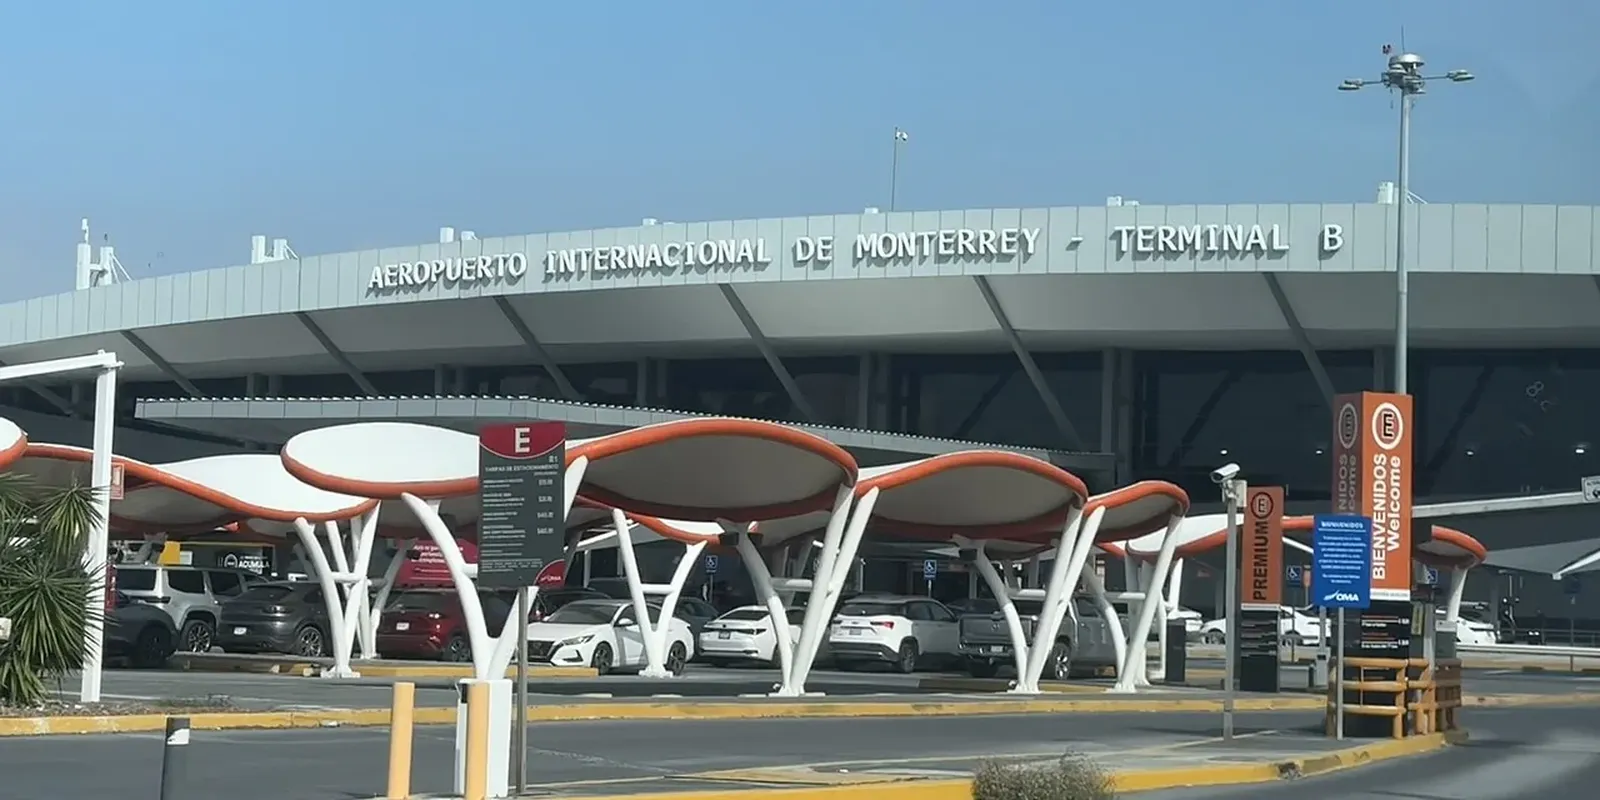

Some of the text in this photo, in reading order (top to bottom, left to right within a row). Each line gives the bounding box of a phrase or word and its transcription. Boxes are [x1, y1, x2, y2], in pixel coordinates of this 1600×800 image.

[367, 252, 527, 289] AEROPUERTO
[545, 238, 771, 275] INTERNACIONAL
[795, 236, 833, 262] DE
[856, 228, 1040, 260] MONTERREY
[1114, 223, 1289, 253] TERMINAL
[1322, 224, 1344, 252] B
[514, 427, 531, 453] E
[1381, 412, 1396, 438] E
[1372, 453, 1388, 580] BIENVENIDOS
[1386, 455, 1402, 551] Welcome
[1253, 520, 1269, 600] PREMIUM
[1336, 593, 1359, 602] OMA
